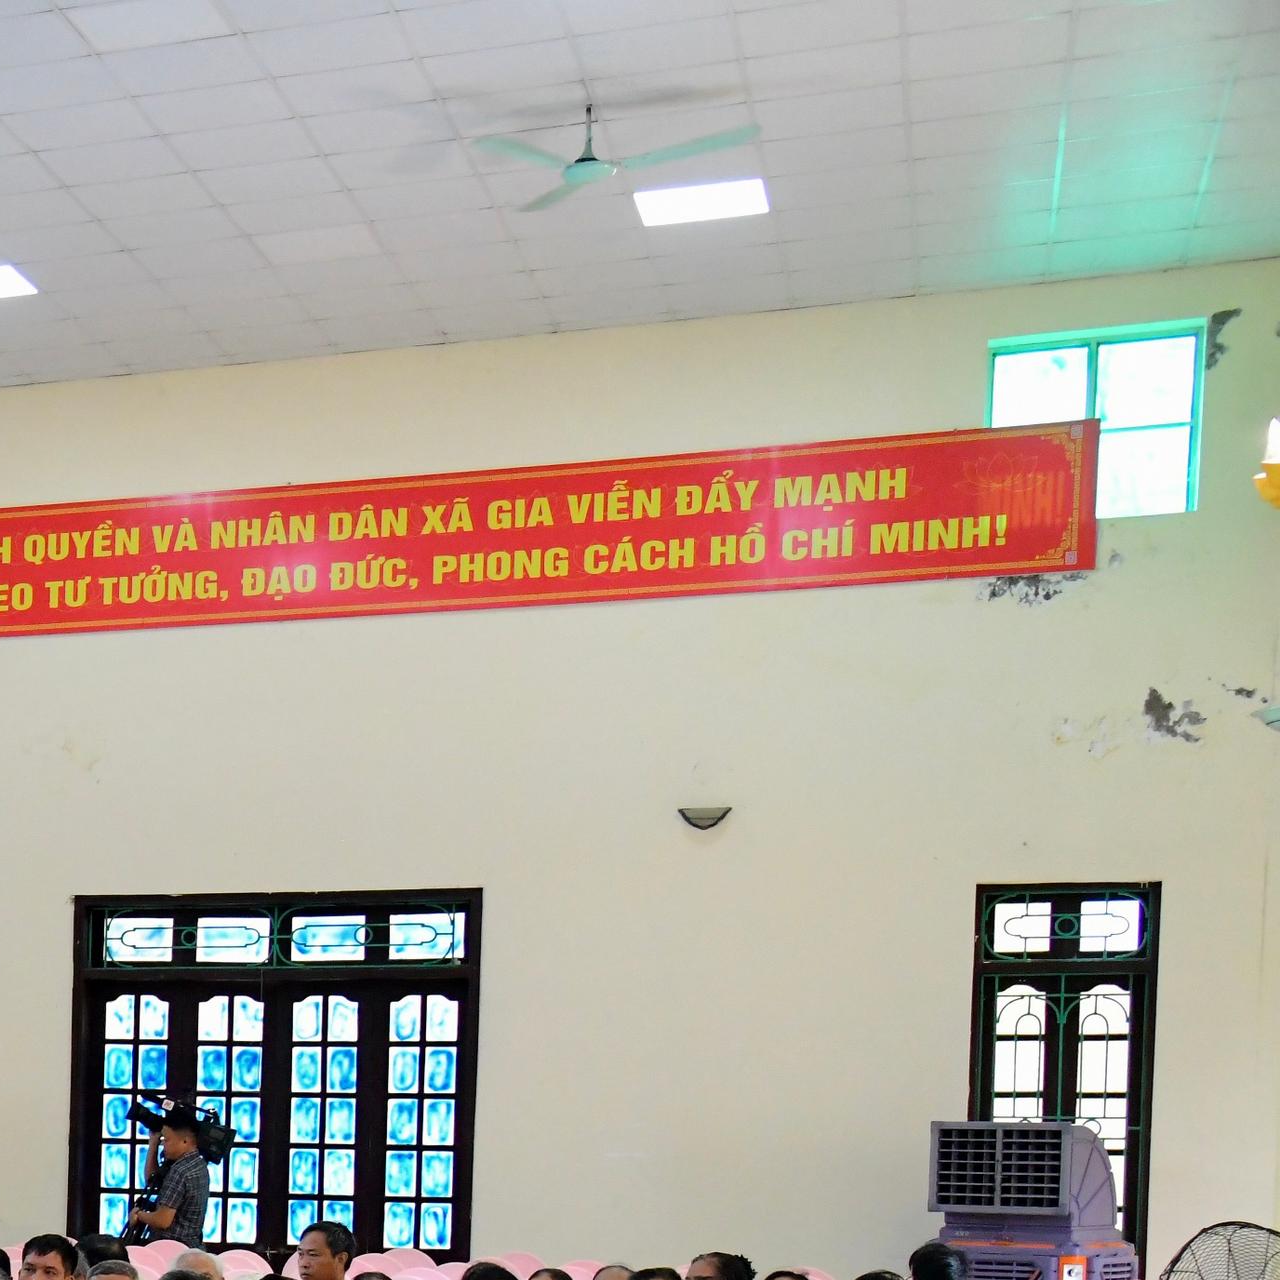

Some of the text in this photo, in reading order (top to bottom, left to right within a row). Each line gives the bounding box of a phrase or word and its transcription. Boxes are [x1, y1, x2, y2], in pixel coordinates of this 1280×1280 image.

[24, 521, 139, 564] QUYỀN
[152, 518, 198, 553] VÀ
[211, 511, 315, 549] NHÂN
[329, 504, 407, 541] DÂN
[422, 498, 473, 534] XÃ
[488, 497, 553, 529] GIA
[568, 480, 661, 523] VIỄN
[675, 470, 759, 515] ĐẨY
[774, 468, 906, 511] MẠNH
[45, 576, 91, 608] TƯ
[99, 565, 228, 604] TƯỞNG,
[242, 564, 316, 600] ĐẠO
[330, 554, 418, 591] ĐỨC,
[433, 547, 568, 584] PHONG
[584, 536, 694, 574] CÁCH
[710, 523, 766, 566] HỒ
[782, 520, 853, 560] CHÍ
[871, 514, 1007, 554] MINH!
